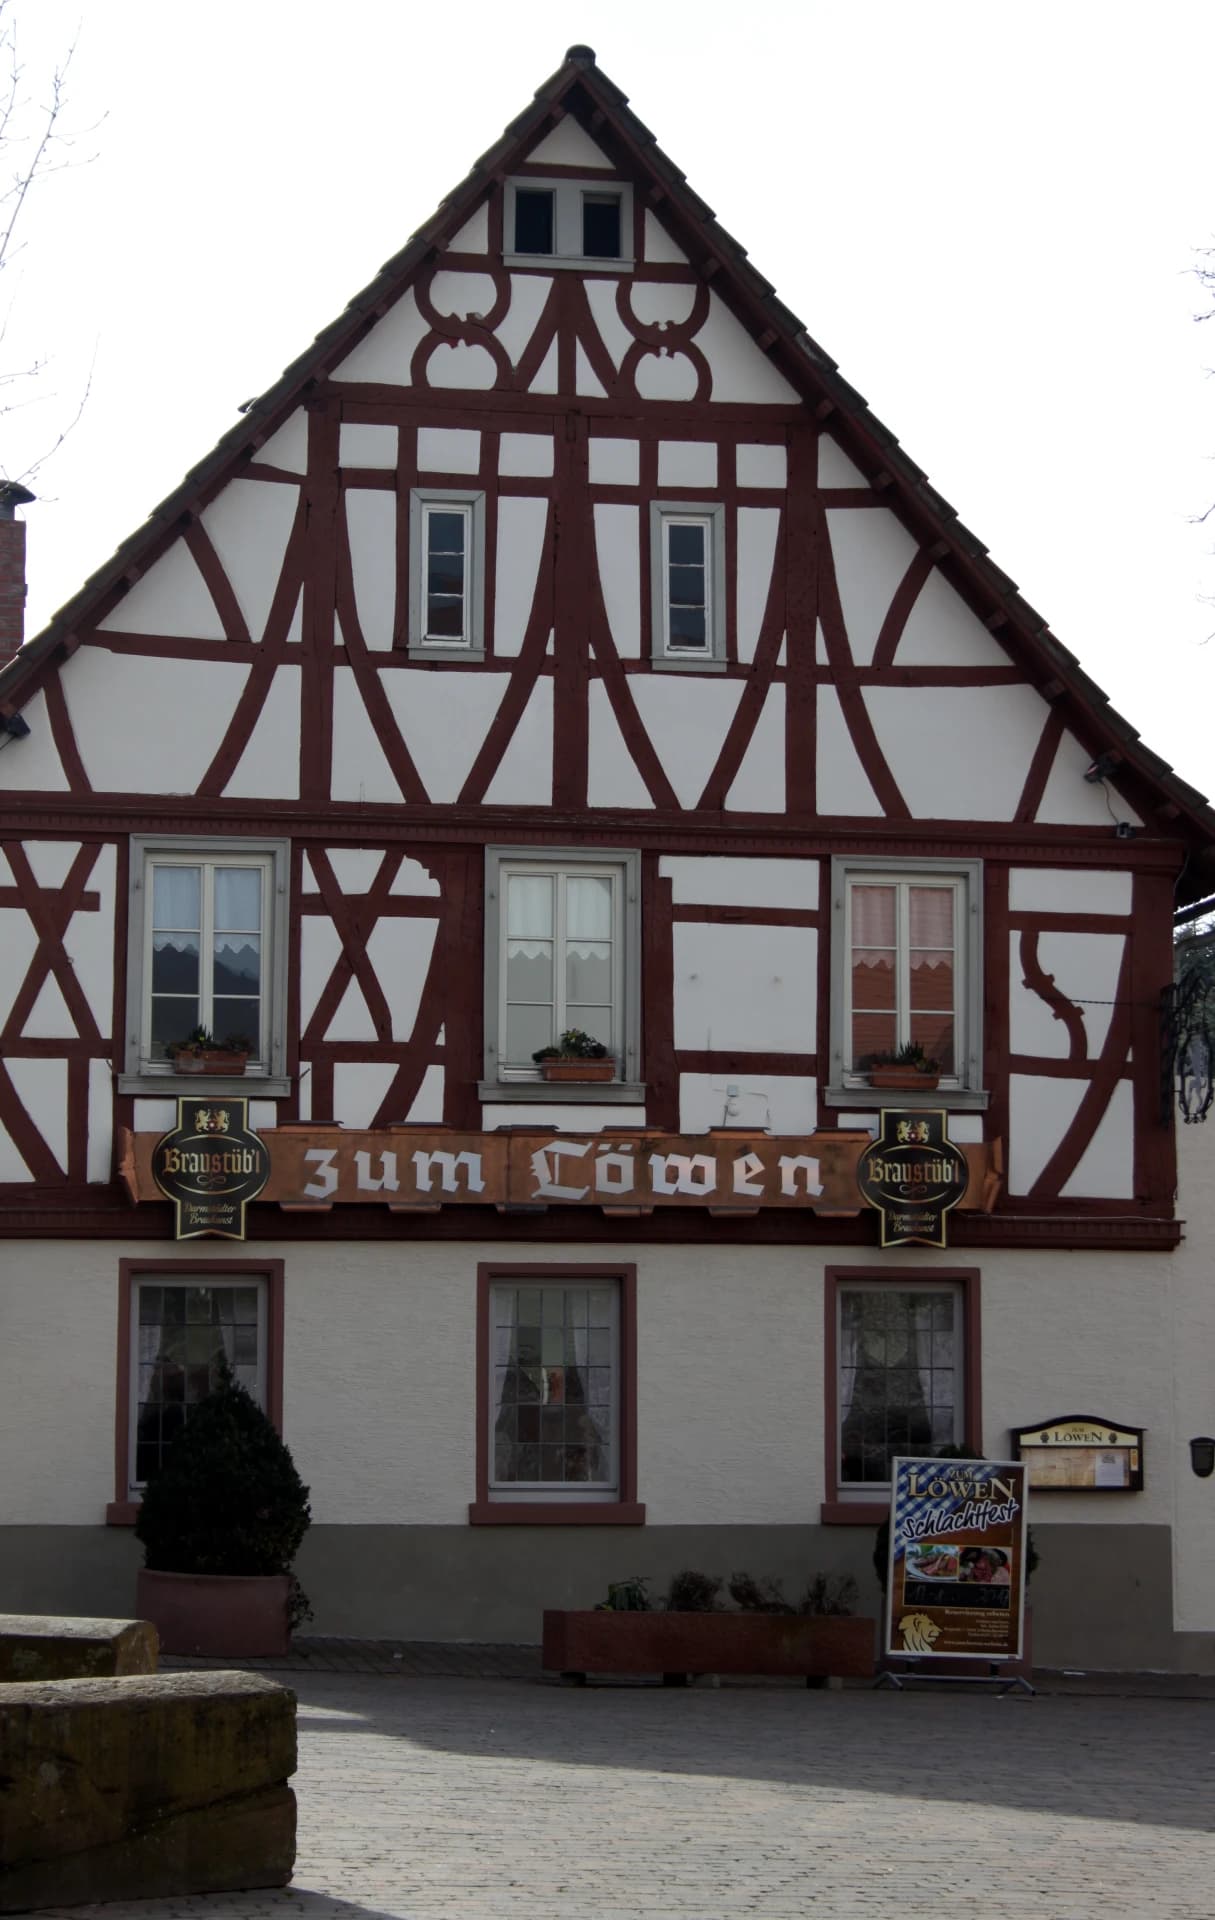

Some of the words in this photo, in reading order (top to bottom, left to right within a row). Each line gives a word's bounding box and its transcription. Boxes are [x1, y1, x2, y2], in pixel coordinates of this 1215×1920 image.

[530, 1140, 825, 1201] Löwen
[908, 1473, 1017, 1500] LÖWEN
[949, 1471, 974, 1480] ZUM
[902, 1498, 1019, 1539] Schlachtfest
